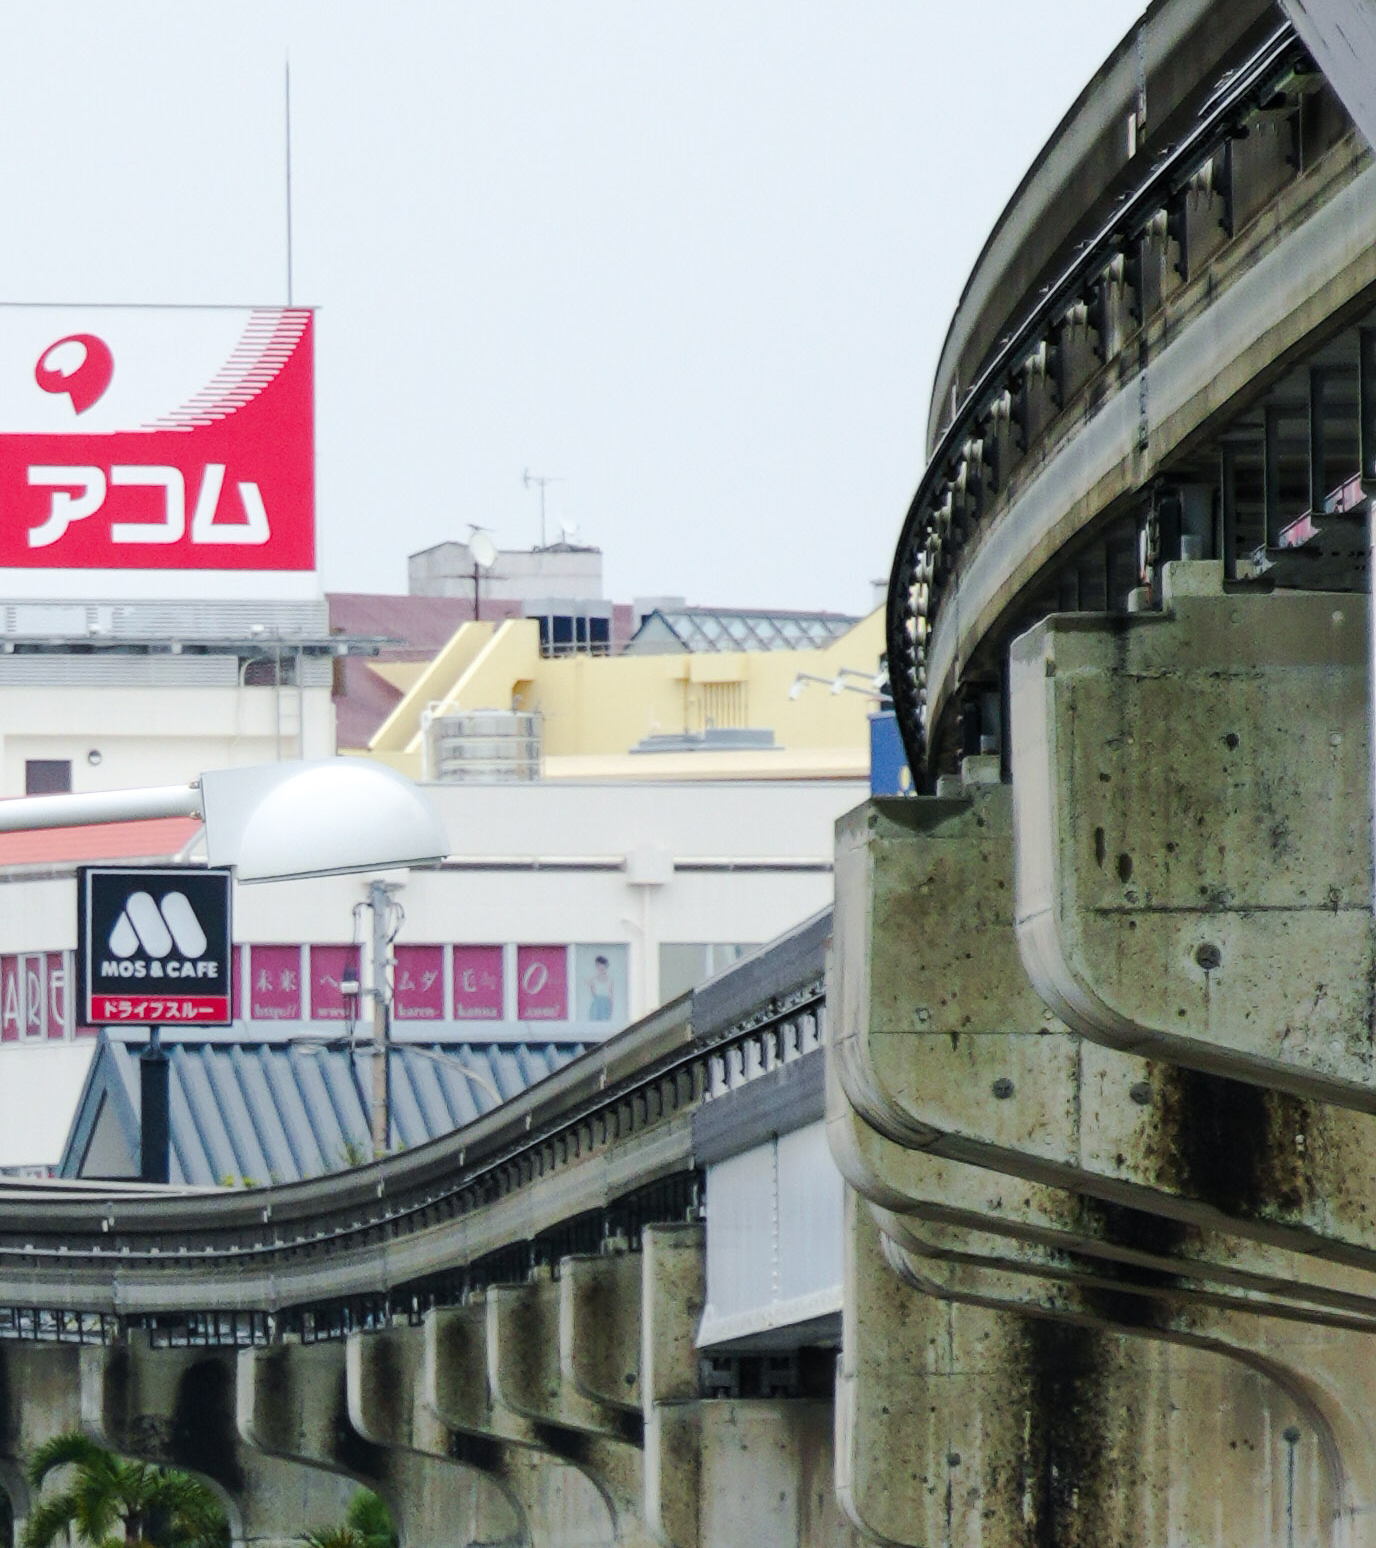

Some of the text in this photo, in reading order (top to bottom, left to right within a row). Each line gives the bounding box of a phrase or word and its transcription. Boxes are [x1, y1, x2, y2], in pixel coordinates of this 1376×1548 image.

[27, 463, 270, 548] アコム
[101, 960, 219, 979] MOS & CAFE
[104, 1001, 214, 1019] ドライブスルー
